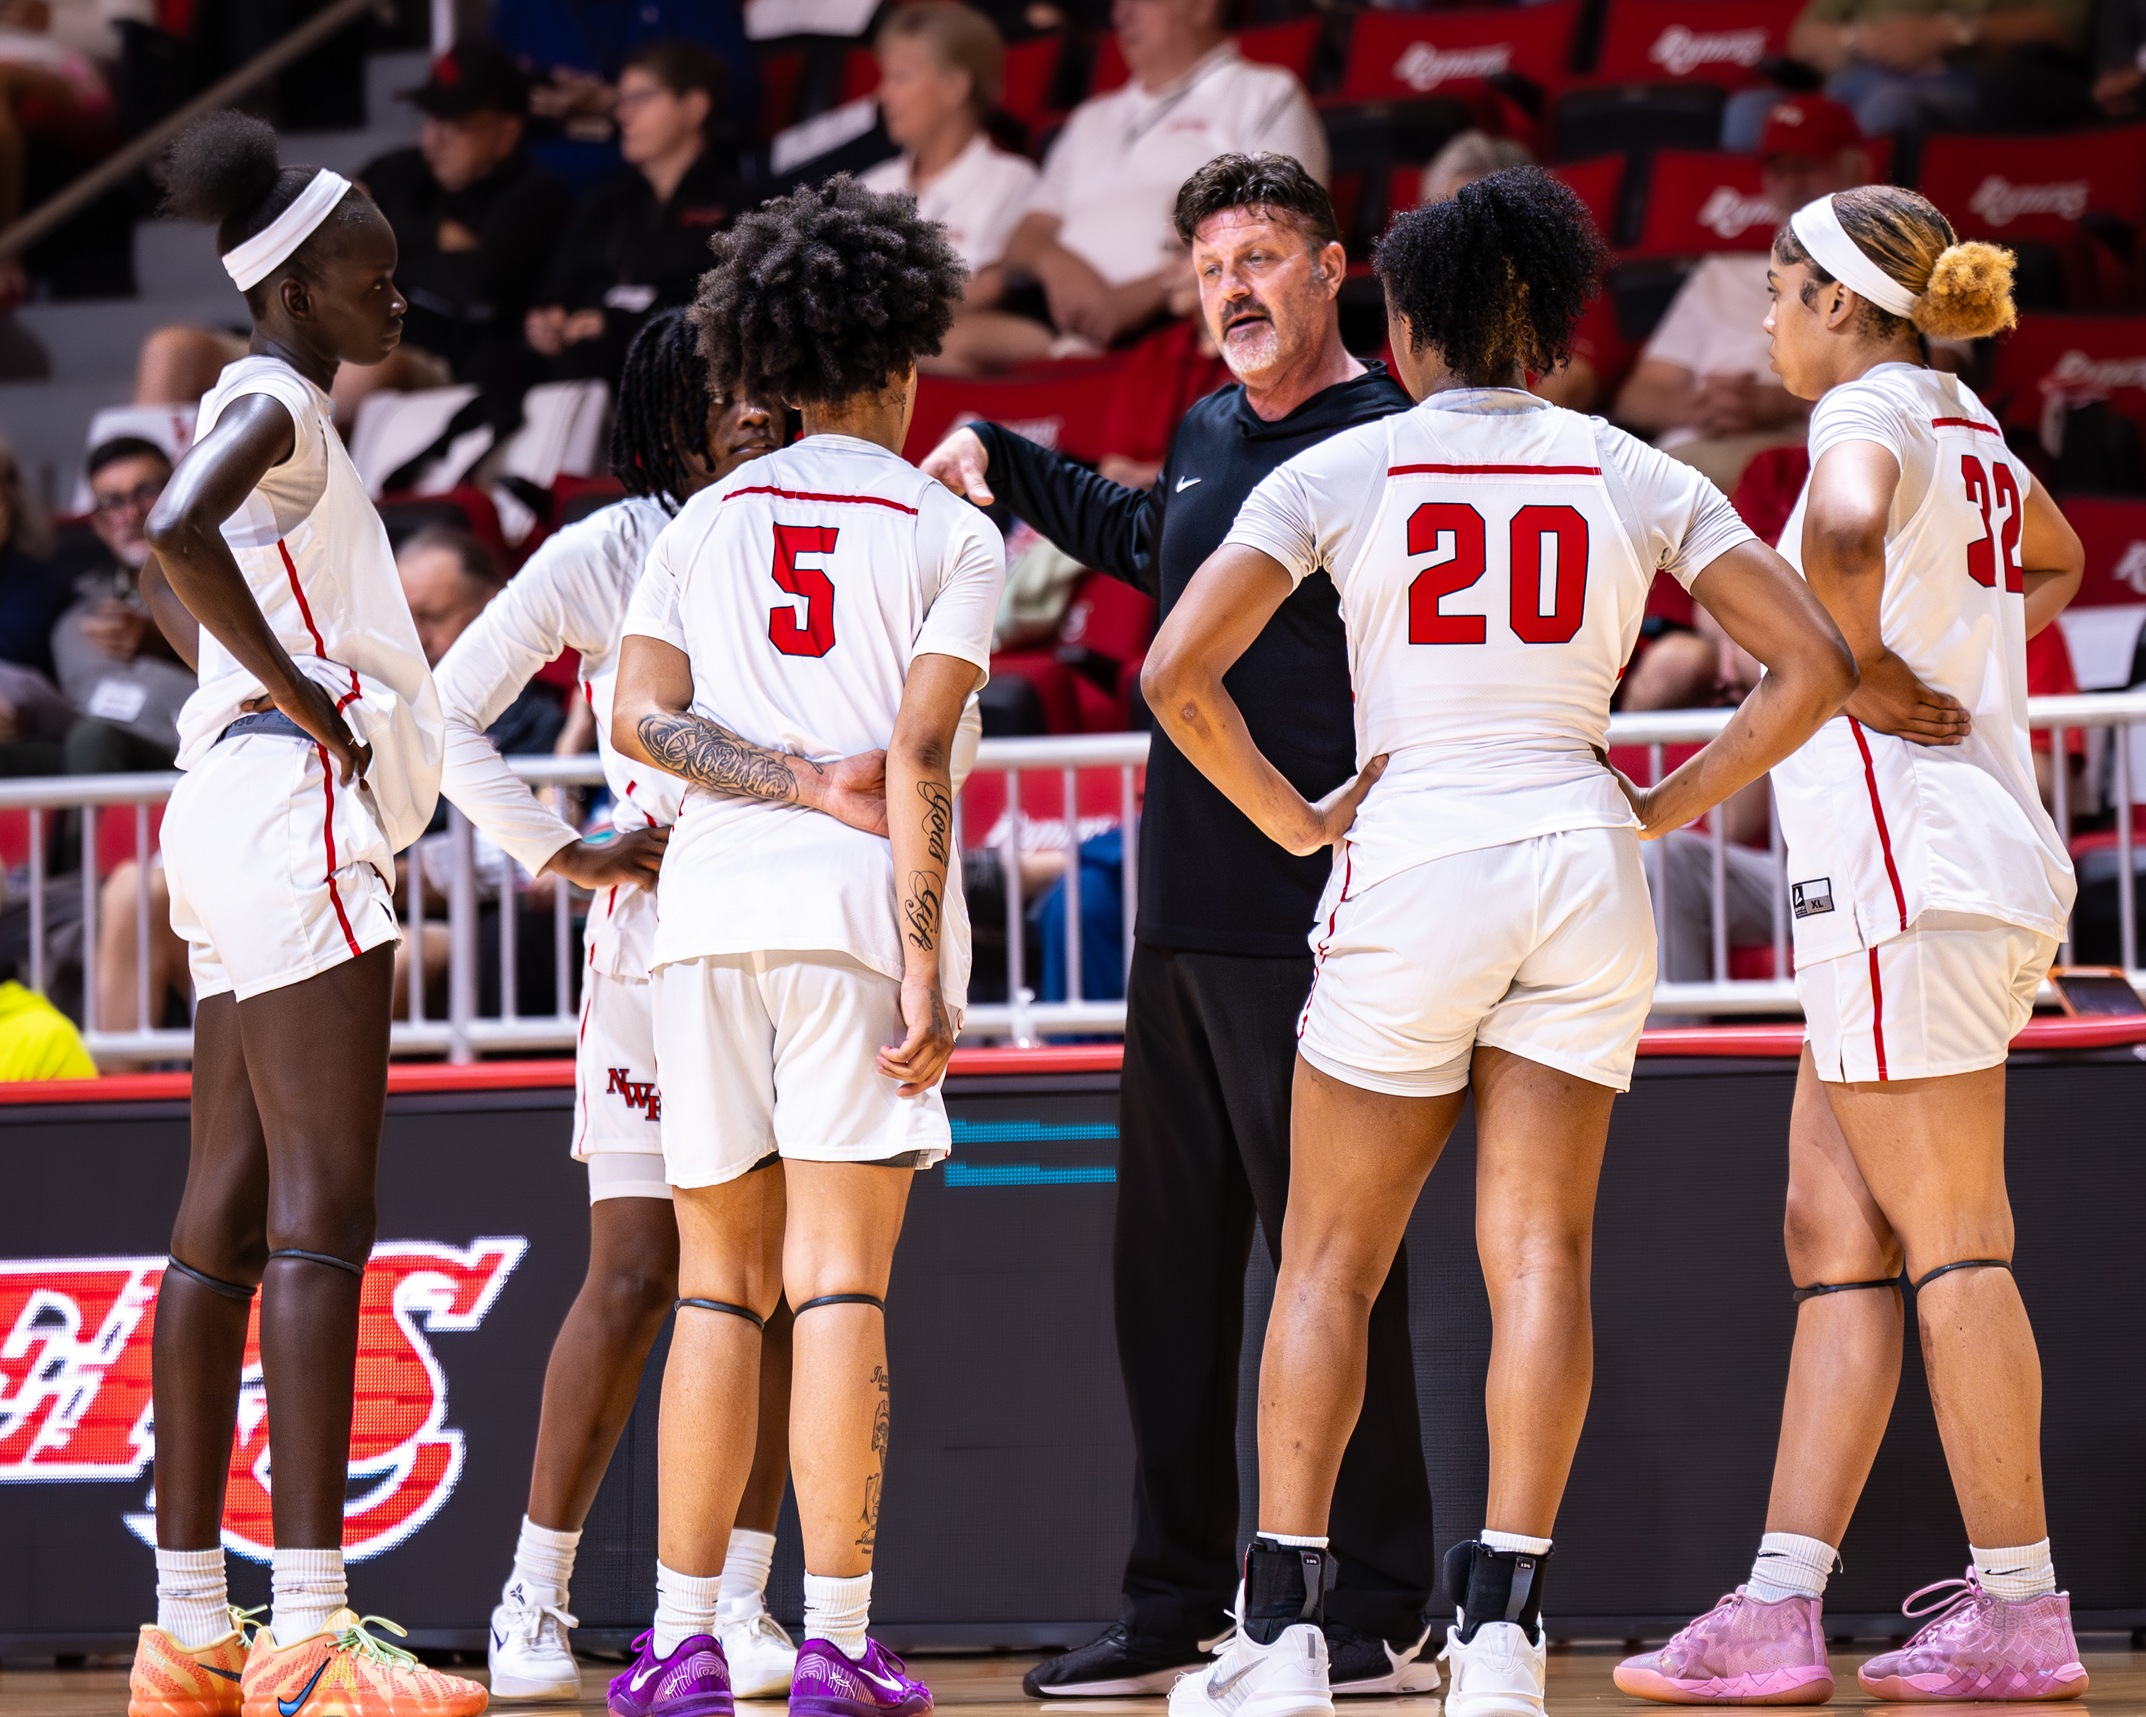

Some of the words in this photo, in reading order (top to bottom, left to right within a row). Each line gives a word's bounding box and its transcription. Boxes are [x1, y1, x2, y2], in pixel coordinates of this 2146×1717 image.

[768, 521, 840, 659] 5
[1407, 502, 1589, 645] 20
[1961, 455, 2024, 593] 32
[905, 870, 943, 952] Gift
[1811, 899, 1824, 910] XL
